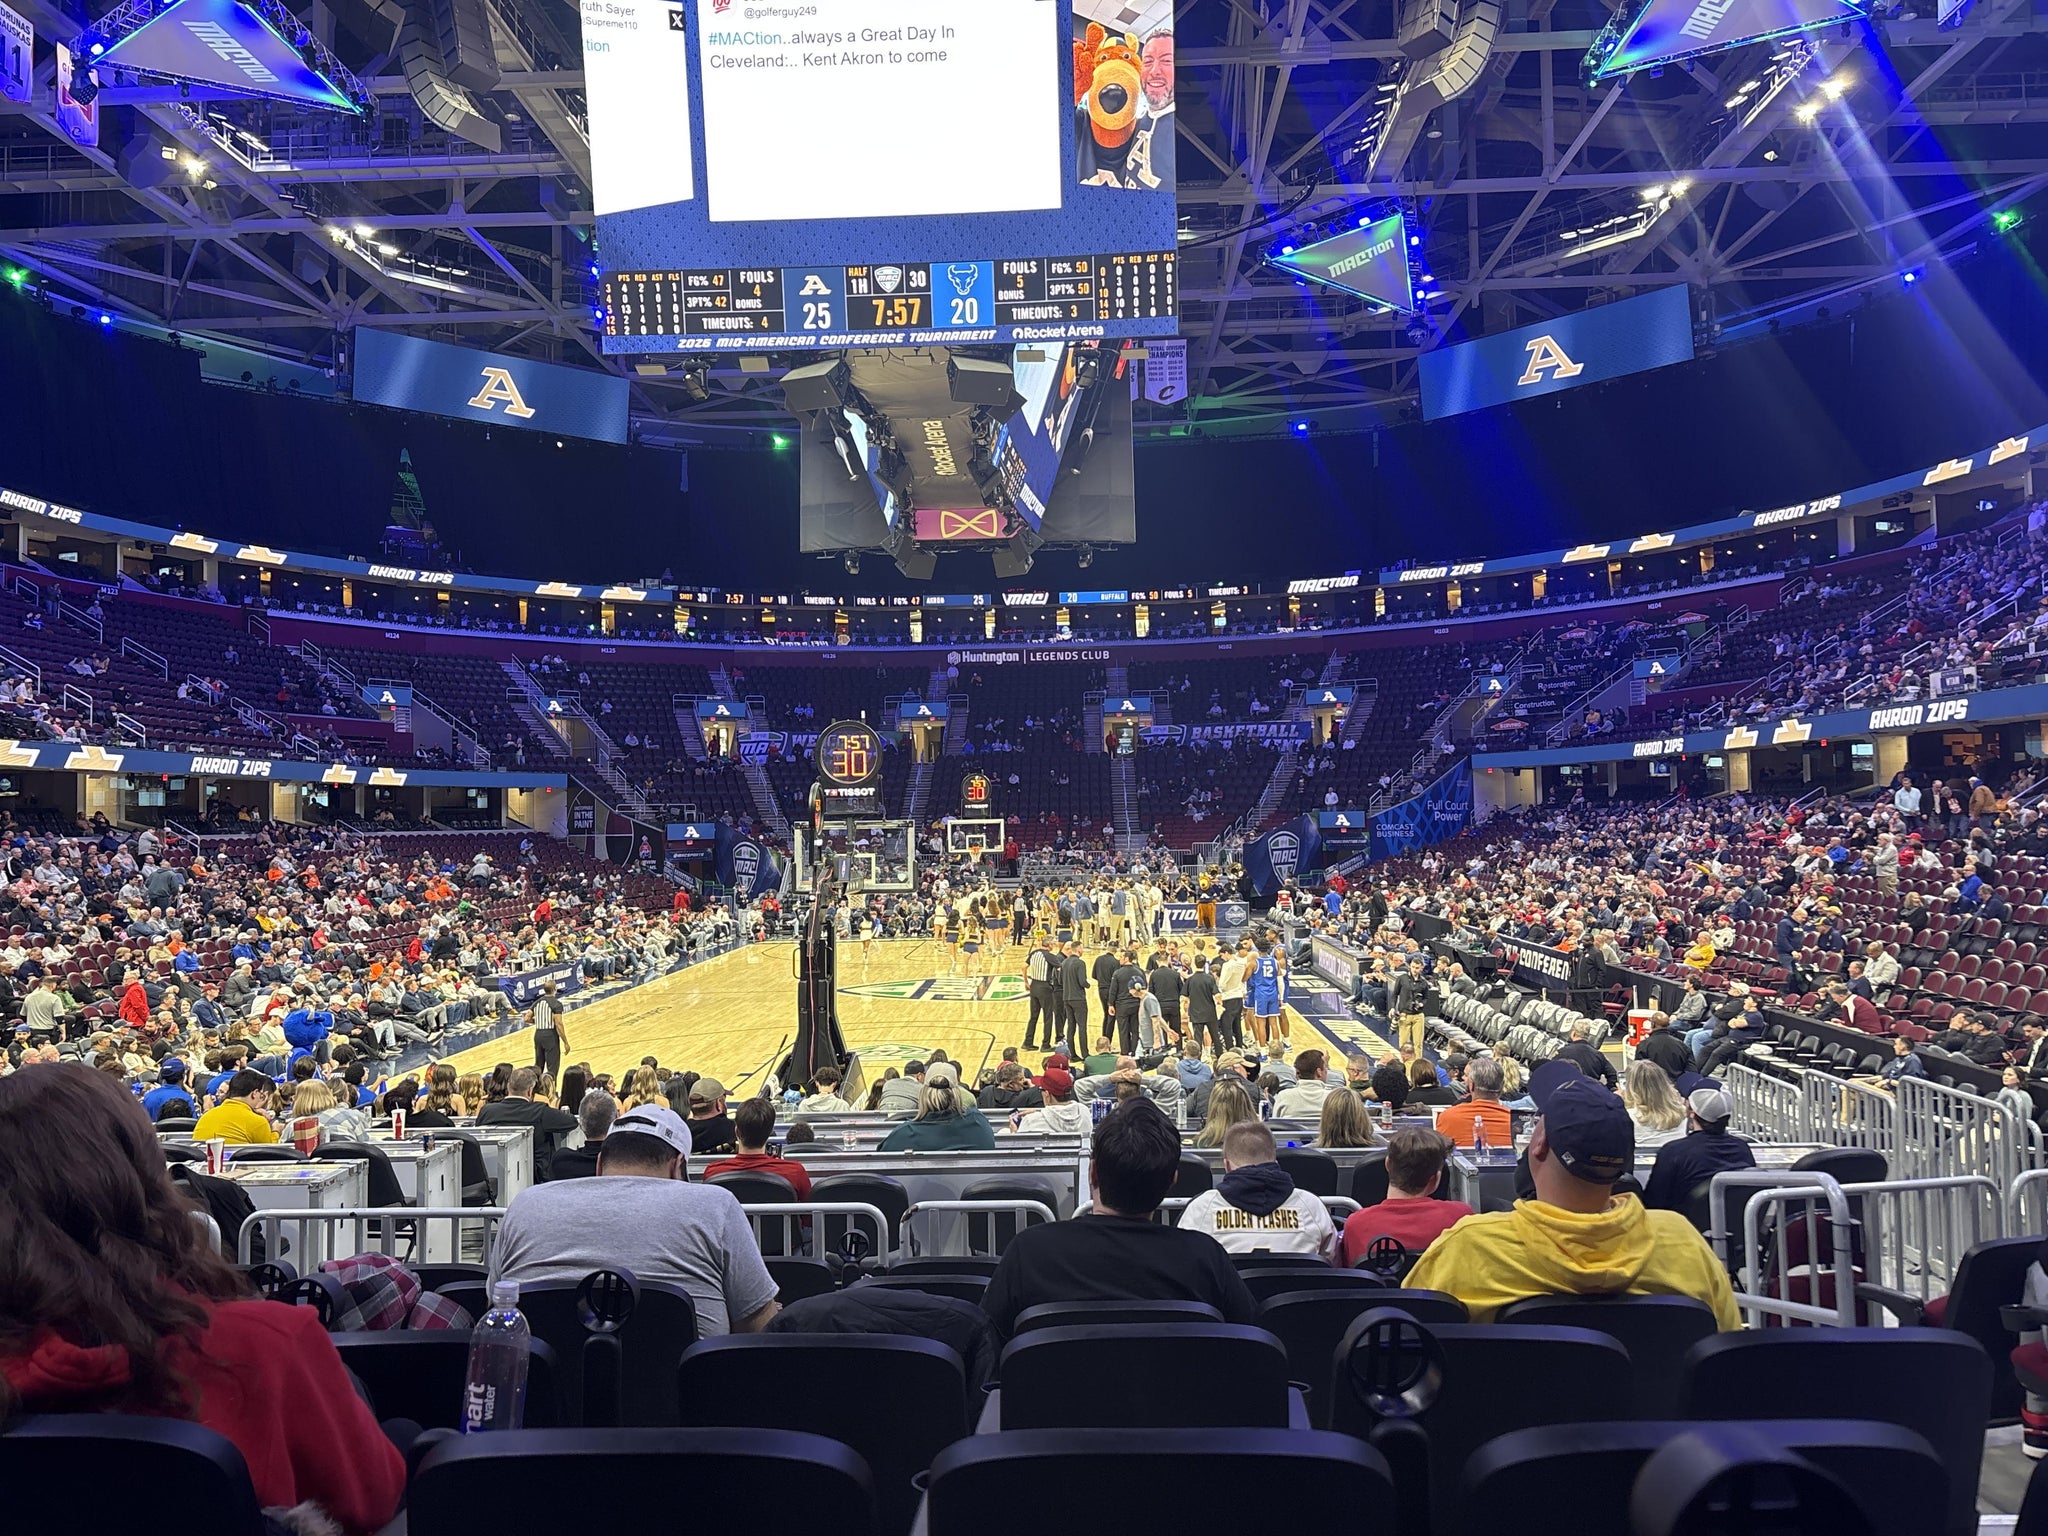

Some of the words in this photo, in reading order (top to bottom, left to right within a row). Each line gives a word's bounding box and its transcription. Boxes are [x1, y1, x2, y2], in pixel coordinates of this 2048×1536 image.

[606, 4, 635, 17] Sayer
[744, 7, 817, 19] @golferguy249
[582, 17, 638, 30] Supreme110
[709, 30, 842, 47] #MACtion..always
[847, 32, 856, 43] a
[861, 27, 902, 42] Great
[907, 26, 937, 43] Day
[941, 25, 955, 39] In
[181, 20, 280, 83] MACTION
[803, 52, 837, 67] Kent
[841, 51, 883, 66] Akron
[889, 50, 902, 63] to
[907, 50, 948, 63] come
[1113, 256, 1125, 264] PTS
[1147, 255, 1158, 263] AST
[1163, 254, 1175, 262] FLS
[1328, 238, 1395, 279] MACTION
[848, 267, 867, 276] HALF
[1003, 261, 1037, 274] FOULS
[1051, 263, 1072, 274] FG%
[1075, 261, 1088, 273] 50
[618, 274, 630, 282] PTS
[668, 273, 679, 281] FLS
[688, 276, 709, 286] FG%
[712, 275, 724, 286] 47
[740, 271, 774, 283] FOULS
[909, 271, 926, 287] 30
[1016, 275, 1024, 288] 5
[753, 284, 761, 296] 4
[799, 275, 832, 295] A
[851, 278, 868, 294] 1H
[1050, 284, 1075, 296] 3PT%
[1077, 283, 1090, 295] 50
[998, 290, 1025, 300] BONUS
[687, 297, 712, 308] 3PT%
[715, 296, 727, 307] 42
[736, 299, 762, 309] BONUS
[803, 303, 832, 329] 25
[872, 298, 921, 326] 7:57
[951, 298, 978, 325] 20
[1011, 307, 1063, 320] TIMEOUTS:
[1070, 305, 1078, 318] 3
[702, 317, 754, 330] TIMEOUTS:
[761, 316, 768, 328] 4
[1024, 327, 1066, 339] Rocket
[1067, 325, 1104, 337] Arena
[677, 338, 713, 349] 2026
[715, 336, 816, 348] MID-AMERICAN
[820, 332, 905, 345] CONFERENCE
[909, 329, 997, 343] TOURNAMENT
[1517, 335, 1585, 386] A
[467, 366, 535, 419] A
[922, 420, 949, 446] Arena
[0, 490, 48, 515] AKRON
[48, 504, 82, 524] ZIPS
[1753, 503, 1806, 528] AKRON
[1808, 495, 1842, 516] ZIPS
[368, 565, 417, 581] AKRON
[418, 570, 454, 585] ZIPS
[1400, 567, 1447, 582] AKRON
[1450, 562, 1484, 576] ZIPS
[1208, 587, 1240, 596] TIMEOUTS:
[1243, 586, 1248, 594] 3
[1287, 576, 1359, 593] MACTION
[698, 593, 707, 602] 30
[725, 594, 744, 604] 7:57
[804, 597, 835, 605] TIMEOUTS:
[838, 597, 844, 605] 4
[911, 597, 920, 605] 47
[973, 595, 984, 605] 25
[1068, 593, 1077, 602] 20
[1131, 592, 1146, 600] FG%
[1149, 591, 1159, 599] 50
[1164, 591, 1184, 599] FOULS
[1187, 590, 1193, 598] 5
[857, 597, 876, 606] FOULS
[962, 651, 1019, 665] Huntington
[1030, 651, 1078, 661] LEGENDS
[1081, 650, 1110, 660] CLUB
[1514, 700, 1556, 709] Construction.
[1869, 705, 1923, 729] AKRON
[1926, 699, 1968, 723] ZIPS
[1191, 724, 1299, 740] BASKETBALL
[838, 735, 869, 750] 7:57
[1633, 741, 1662, 758] AKRON
[1663, 737, 1684, 754] ZIPS
[190, 756, 239, 775] AKRON
[240, 760, 272, 776] ZIPS
[832, 750, 867, 777] 30
[839, 787, 875, 796] TISSOT
[968, 787, 984, 800] 30
[1427, 800, 1445, 811] Full
[1447, 801, 1468, 811] Court
[1434, 811, 1462, 822] Power
[574, 820, 593, 828] PAINT
[1376, 830, 1414, 838] BUSINESS
[1272, 849, 1297, 862] MAC
[736, 860, 756, 873] MAC
[1519, 948, 1571, 980] CONFEREN
[1262, 966, 1273, 978] 12
[1216, 1209, 1253, 1229] GOLDEN
[484, 1385, 496, 1420] water
